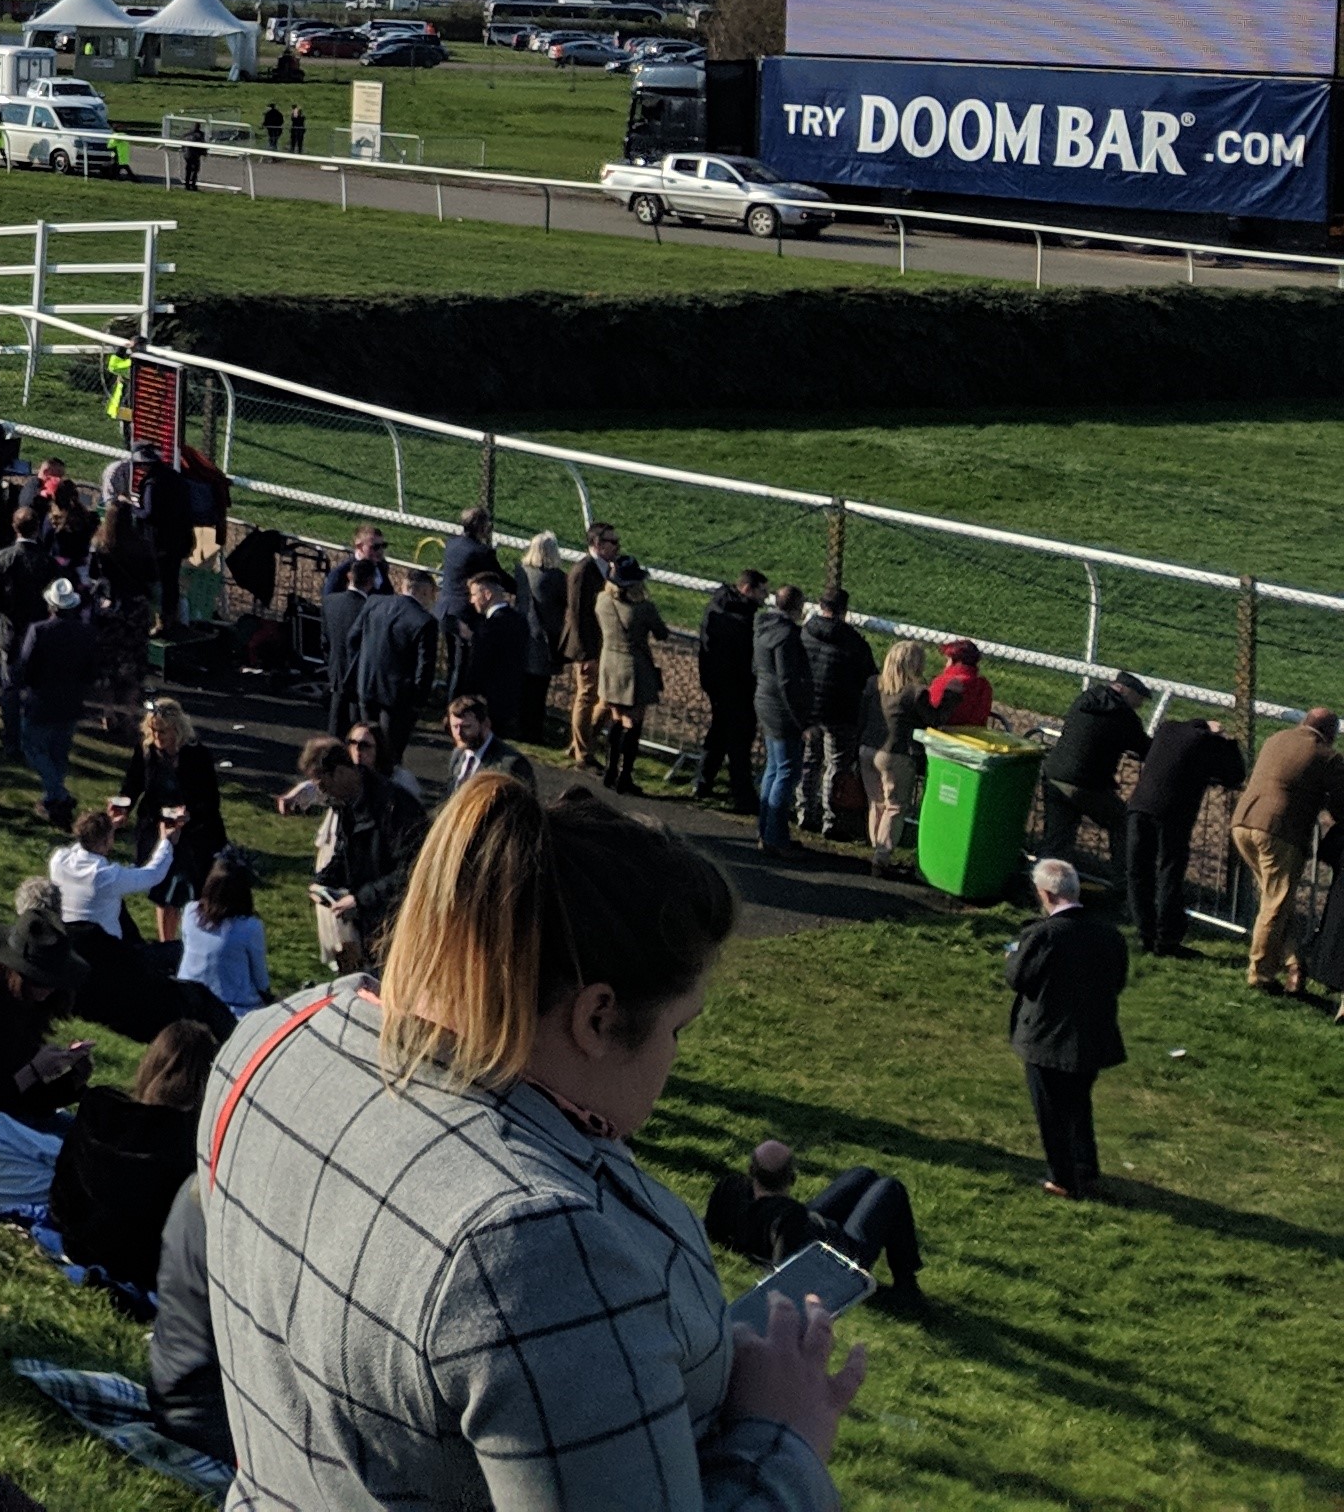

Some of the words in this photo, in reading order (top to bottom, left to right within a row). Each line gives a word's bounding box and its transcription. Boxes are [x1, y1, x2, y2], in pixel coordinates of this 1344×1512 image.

[782, 103, 847, 138] TRY
[856, 94, 1045, 166] DOOM
[1204, 129, 1306, 169] .COM
